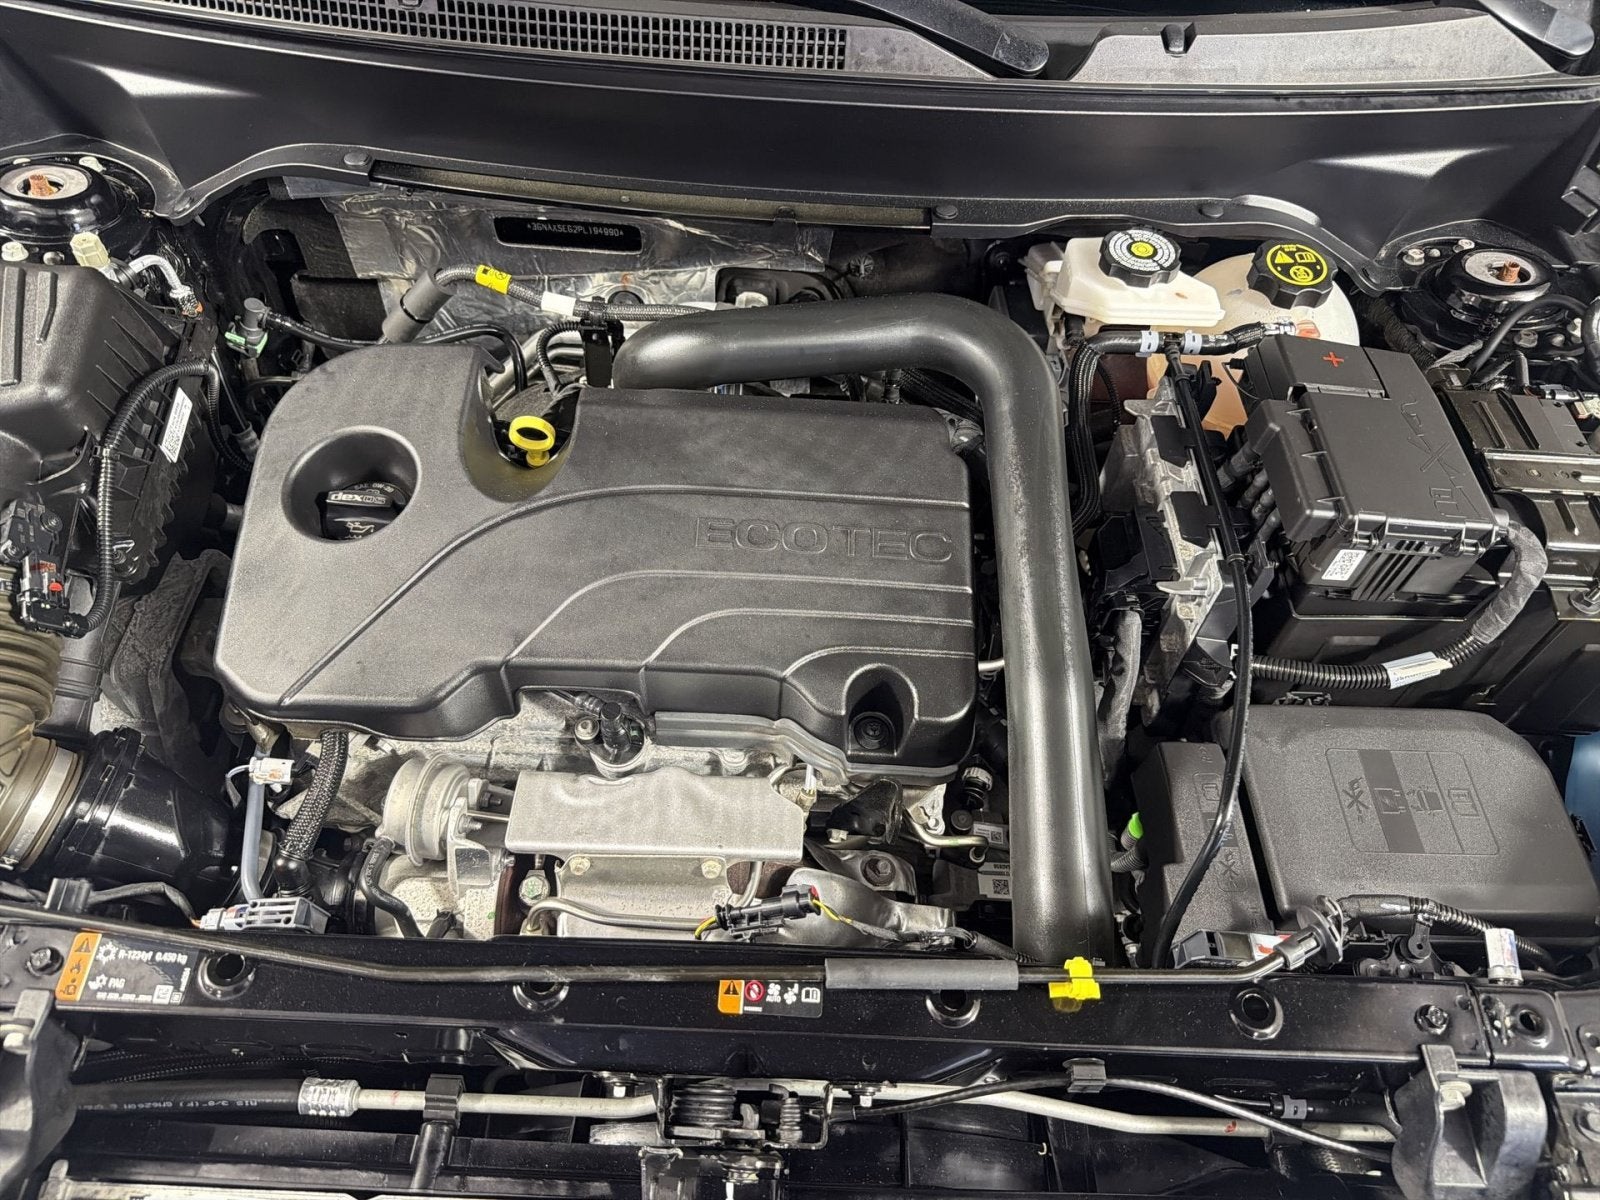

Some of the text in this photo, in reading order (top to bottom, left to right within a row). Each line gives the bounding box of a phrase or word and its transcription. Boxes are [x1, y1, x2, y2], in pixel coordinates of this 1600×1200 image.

[695, 517, 952, 563] ECOTEC
[108, 977, 126, 989] PAG
[766, 995, 781, 1003] AUTO
